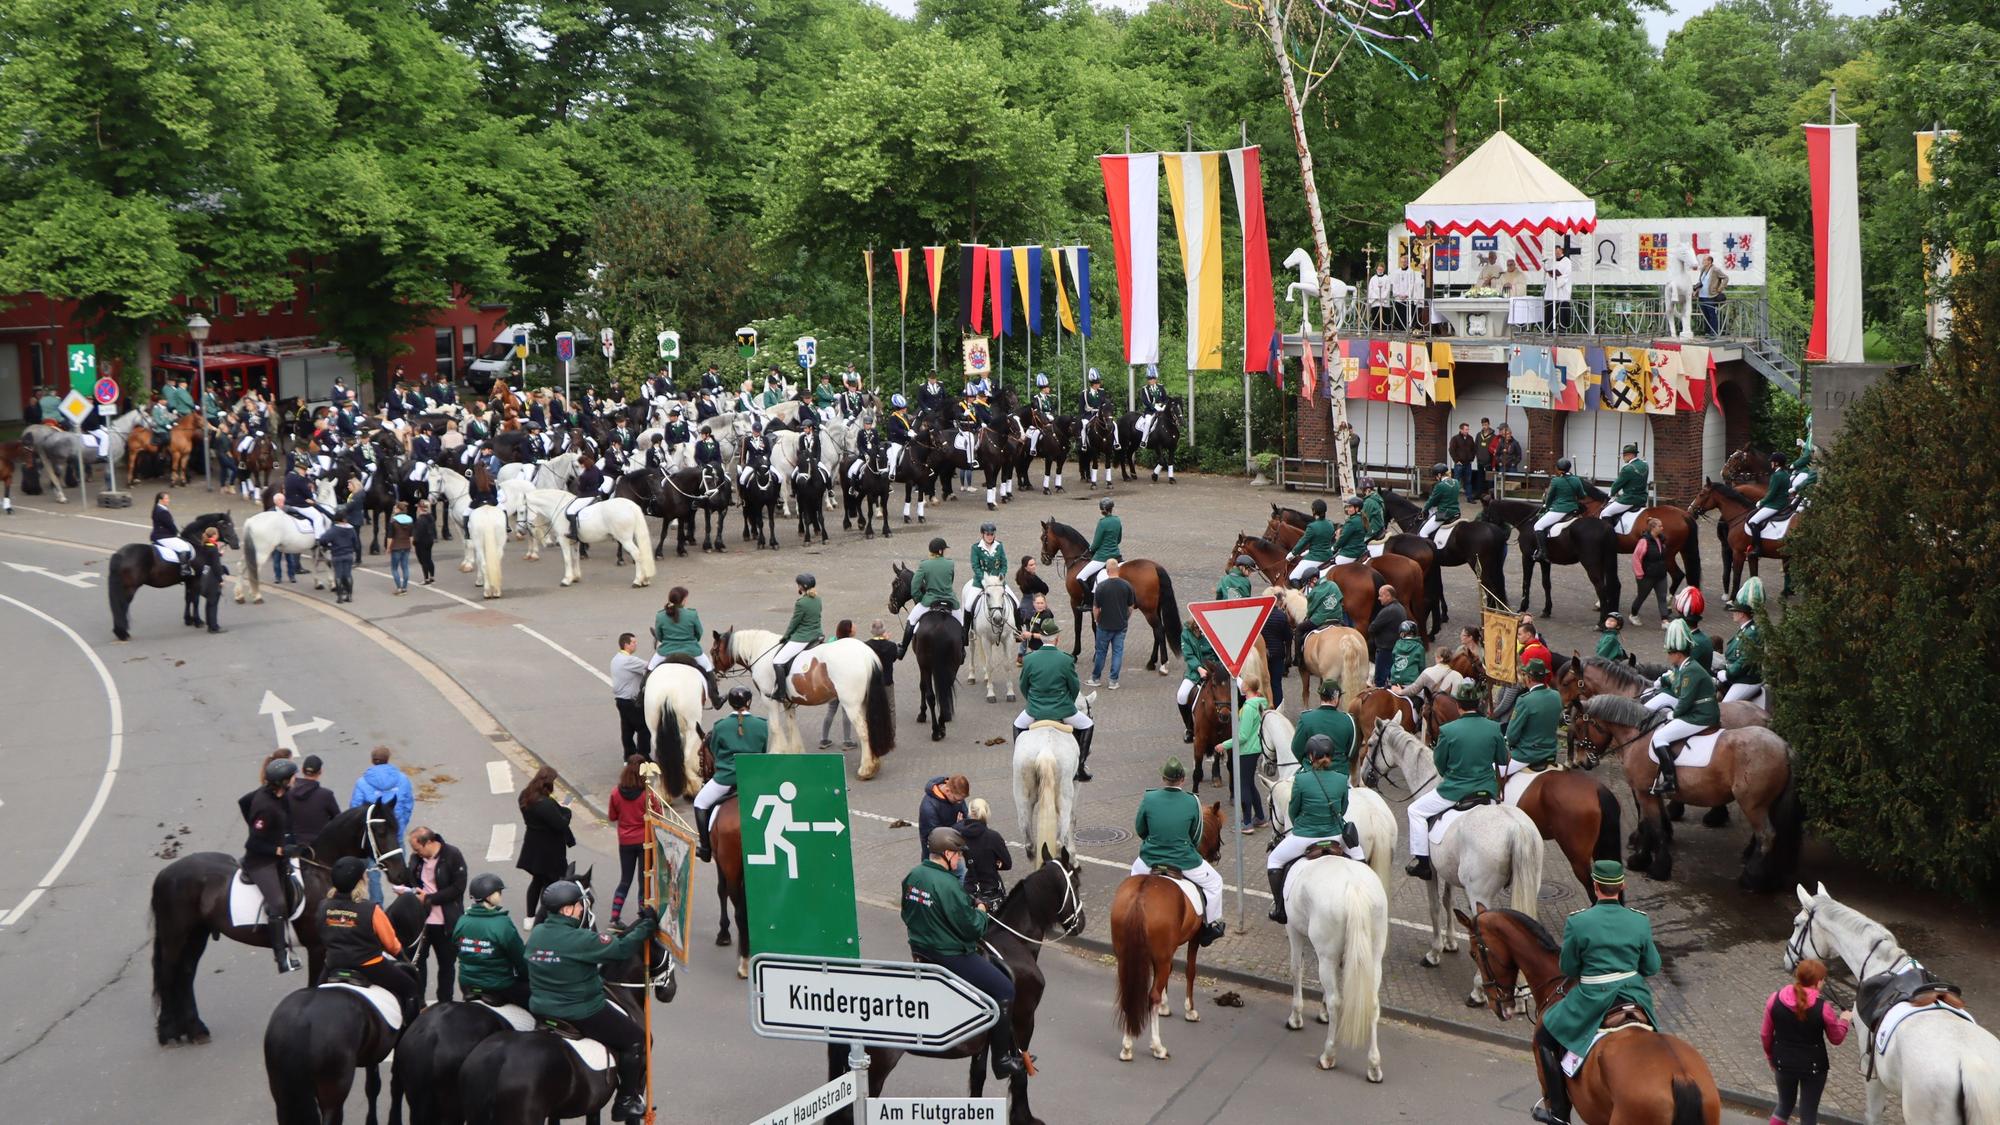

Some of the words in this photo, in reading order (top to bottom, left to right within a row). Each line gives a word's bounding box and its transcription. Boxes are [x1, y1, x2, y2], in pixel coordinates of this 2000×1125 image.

[789, 984, 929, 1022] Kindergarten
[793, 1081, 852, 1124] Hauptstraße
[880, 1103, 904, 1120] Am
[911, 1103, 994, 1124] Flutgraben
